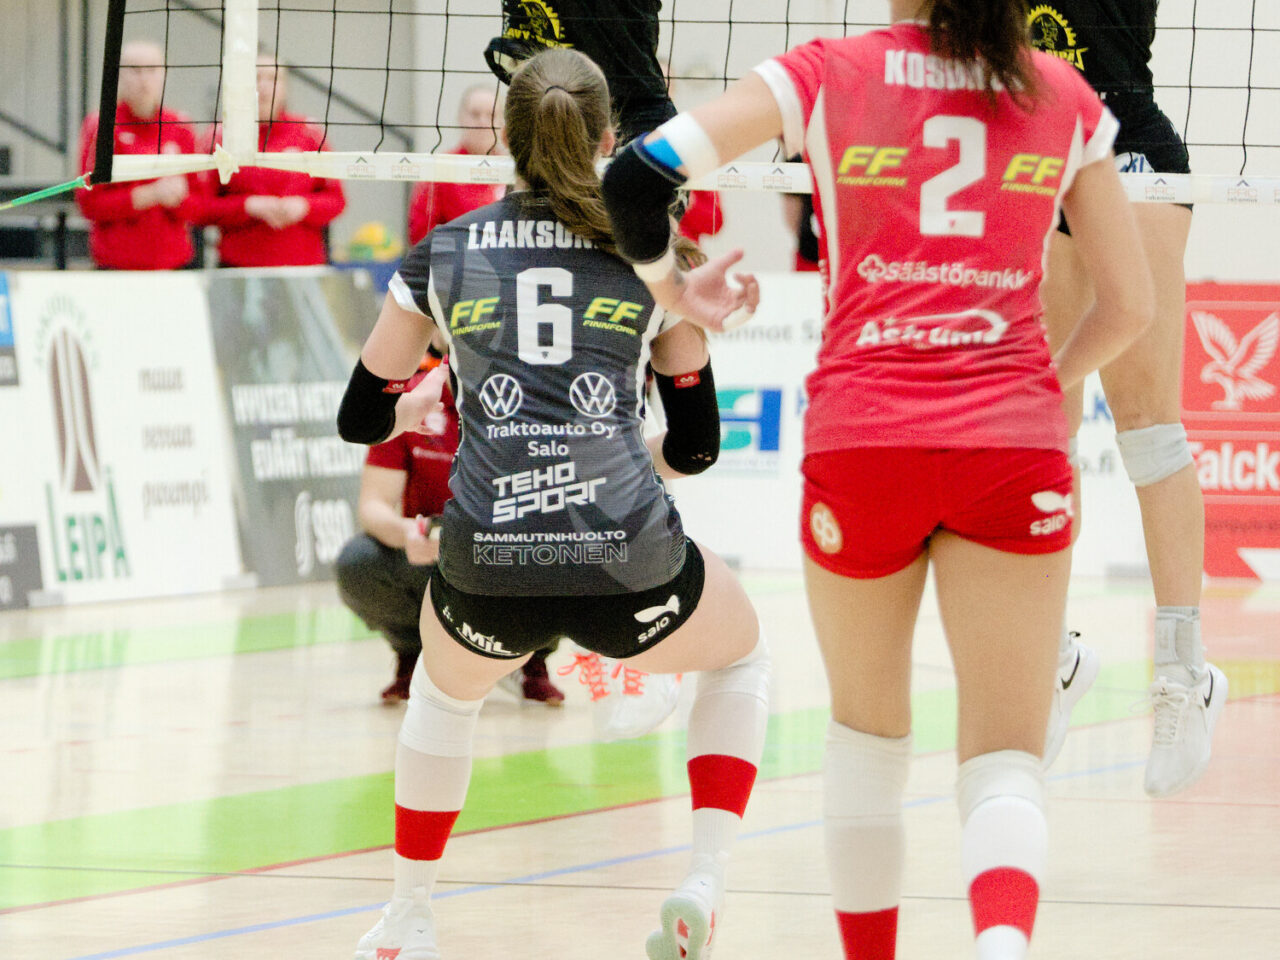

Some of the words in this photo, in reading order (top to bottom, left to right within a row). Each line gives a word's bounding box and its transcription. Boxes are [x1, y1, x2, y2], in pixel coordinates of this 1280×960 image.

[838, 145, 909, 176] FF
[1002, 153, 1064, 184] FF
[920, 115, 987, 238] 2
[450, 296, 501, 328] FF
[516, 267, 573, 365] 6
[583, 296, 645, 323] FF
[583, 319, 638, 336] FINNFORM
[487, 421, 586, 439] Traktoauto
[591, 421, 617, 439] Oy
[527, 440, 570, 457] Salo
[492, 461, 576, 498] TEHO
[492, 477, 607, 524] SPORT
[473, 530, 626, 542] SAMMUTINHUOLTO
[1030, 514, 1065, 537] salo
[473, 541, 628, 565] KETONEN
[637, 616, 669, 644] salo
